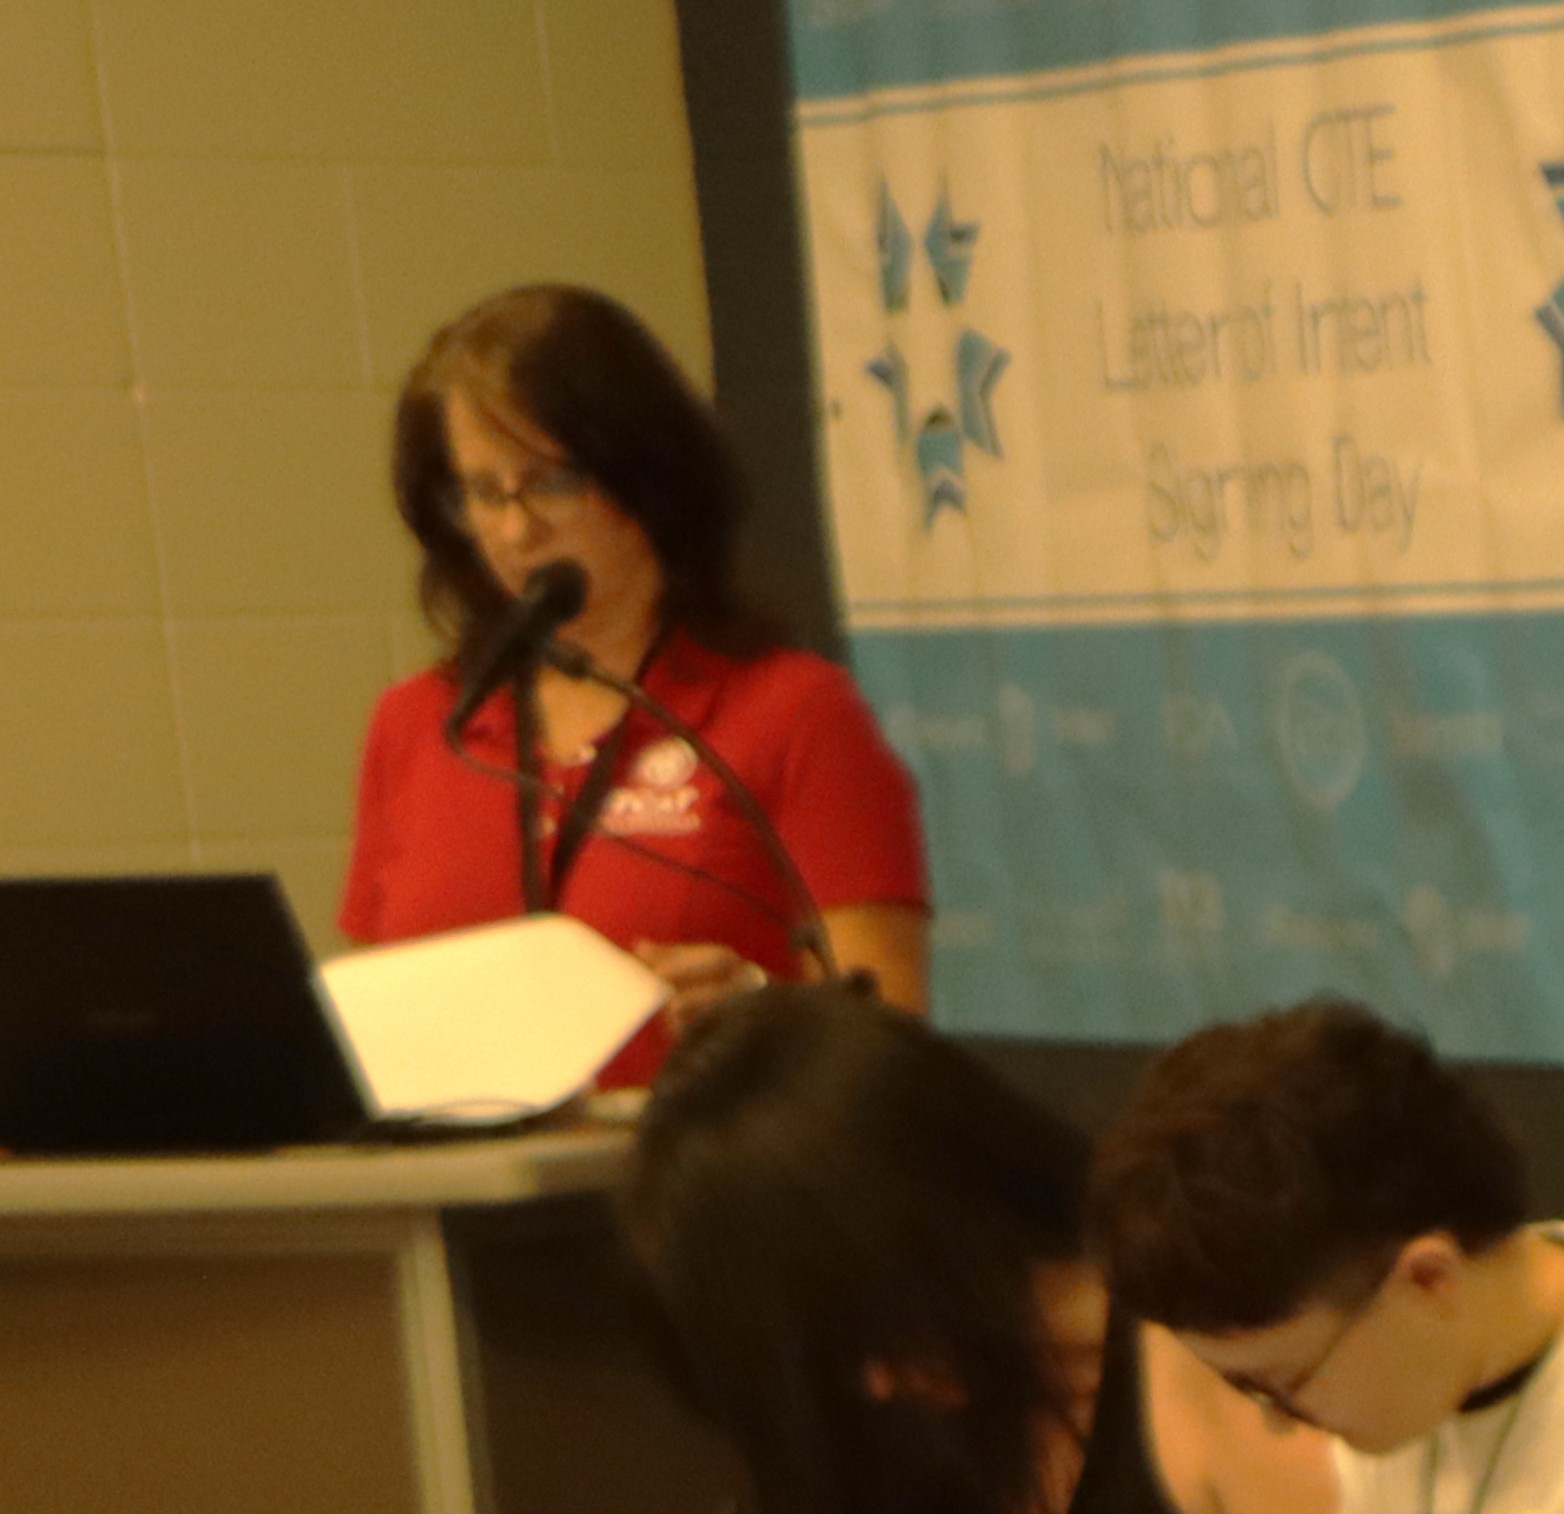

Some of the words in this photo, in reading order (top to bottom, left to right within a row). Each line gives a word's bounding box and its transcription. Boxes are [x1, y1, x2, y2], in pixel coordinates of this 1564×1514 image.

[1097, 116, 1281, 237] National
[1302, 103, 1404, 218] CTE
[1095, 297, 1223, 394] Letter
[1331, 432, 1423, 555] Day
